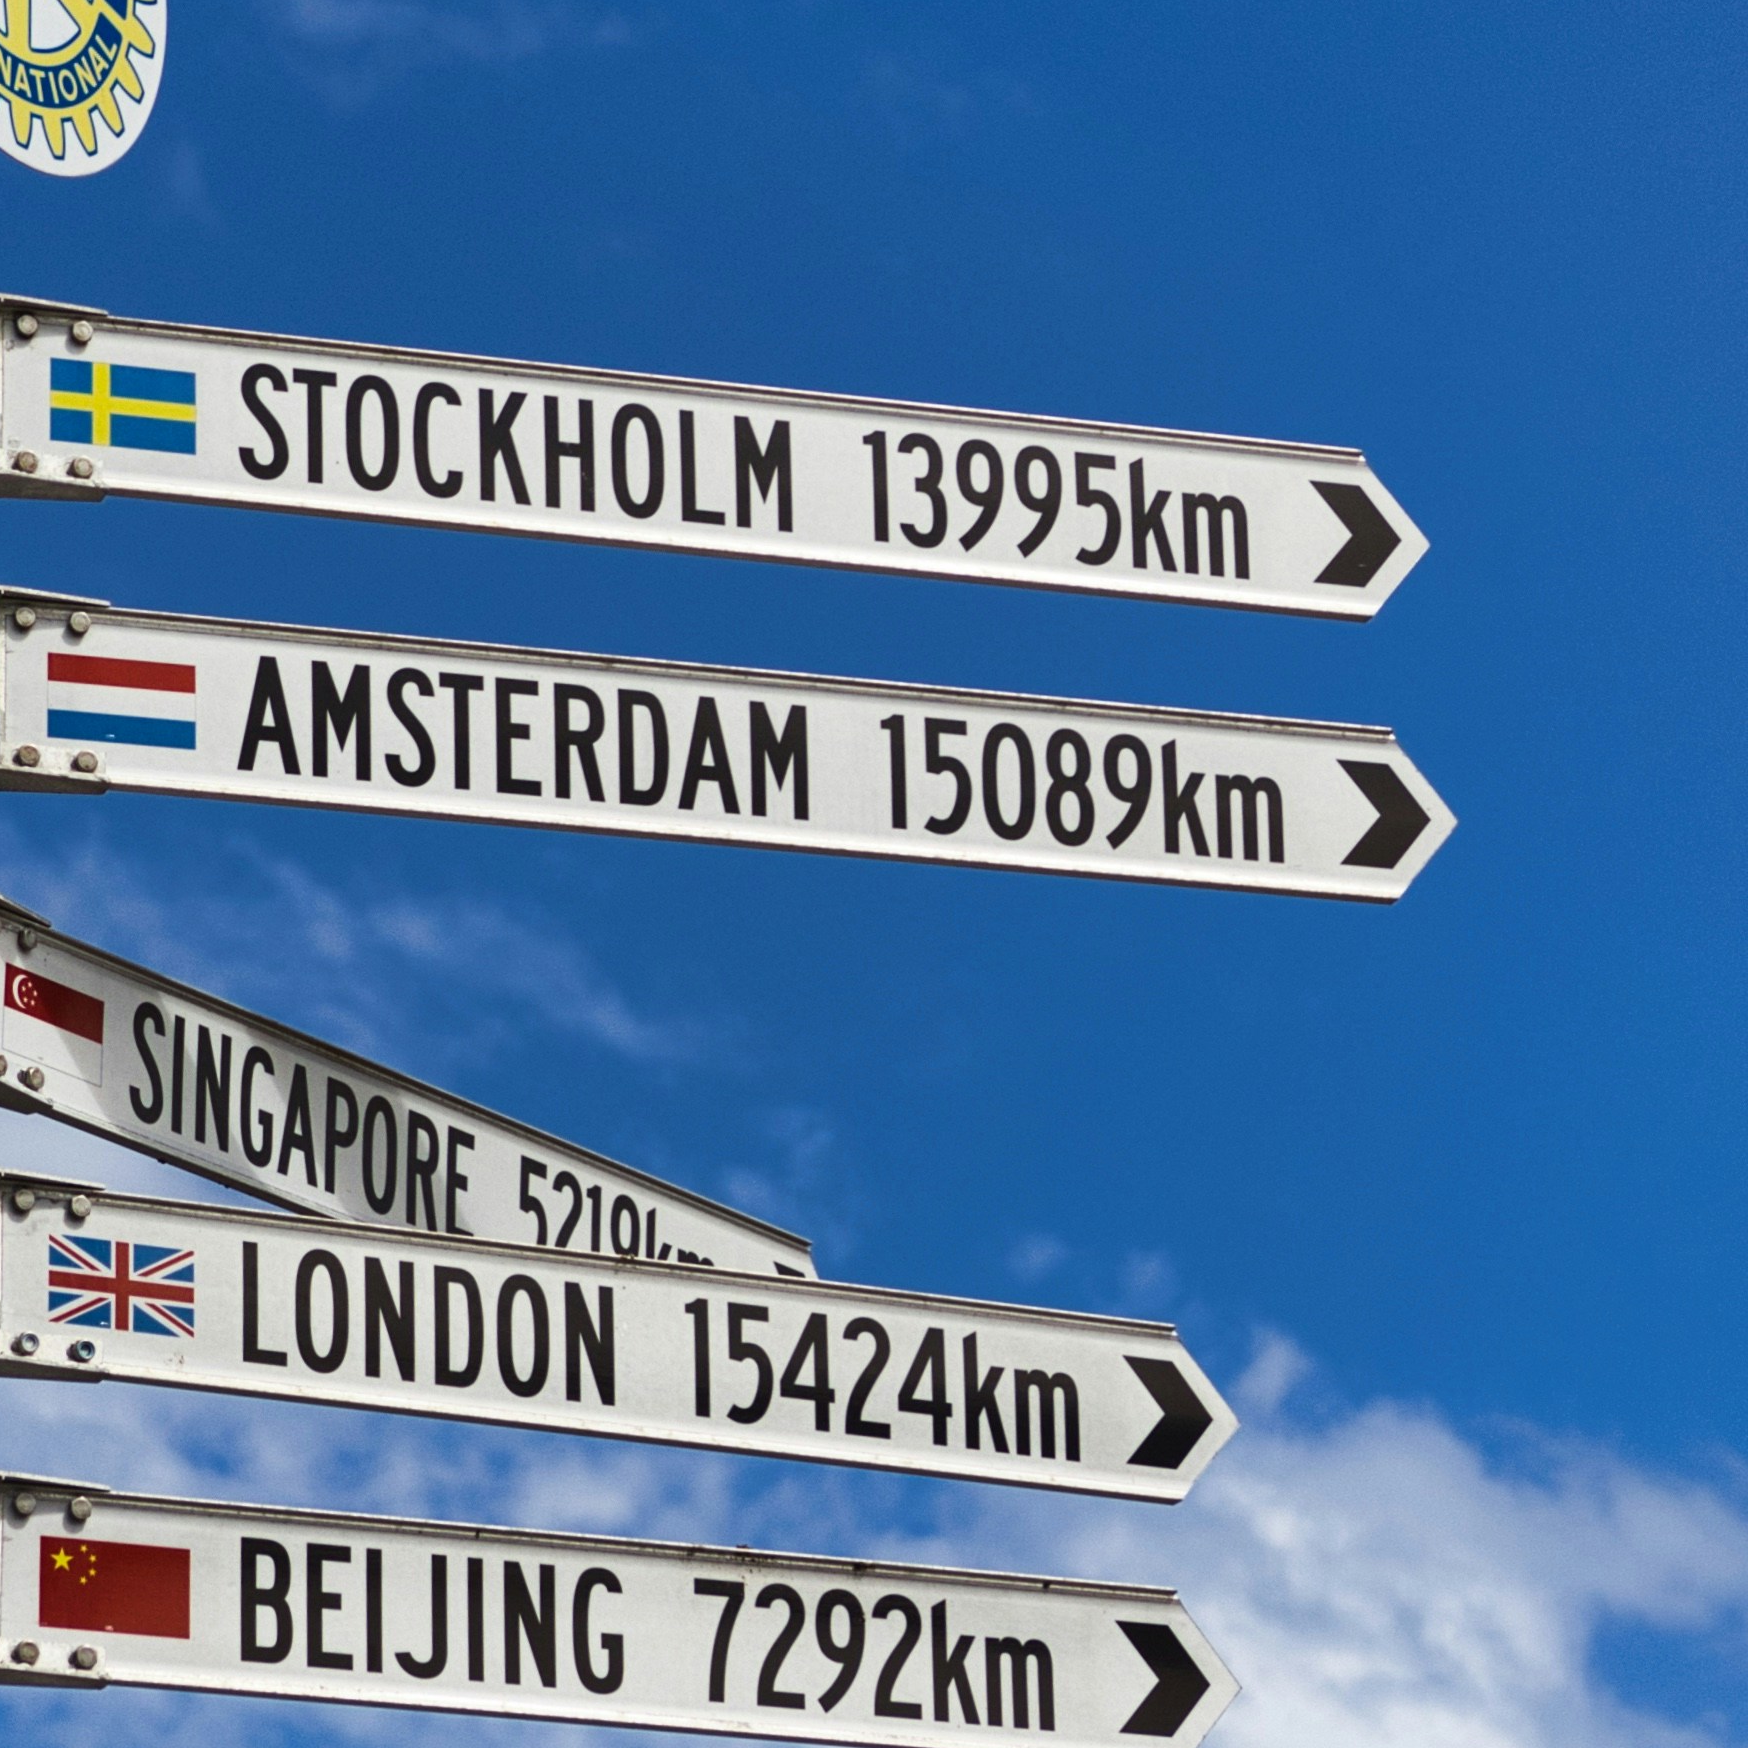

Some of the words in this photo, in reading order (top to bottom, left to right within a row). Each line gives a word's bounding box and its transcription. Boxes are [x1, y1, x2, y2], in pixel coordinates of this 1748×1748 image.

[238, 363, 793, 533] STOCKHOLM
[862, 430, 1250, 580] 13995km
[237, 655, 809, 821] AMSTERDAM
[880, 714, 1285, 864] 15089km
[128, 1000, 476, 1238] SINGAPORE
[519, 1154, 715, 1267] 5219
[242, 1240, 616, 1407] LONDON
[684, 1298, 1081, 1463] 15424km
[240, 1536, 624, 1695] BEIJING
[693, 1577, 1055, 1732] 7292km
